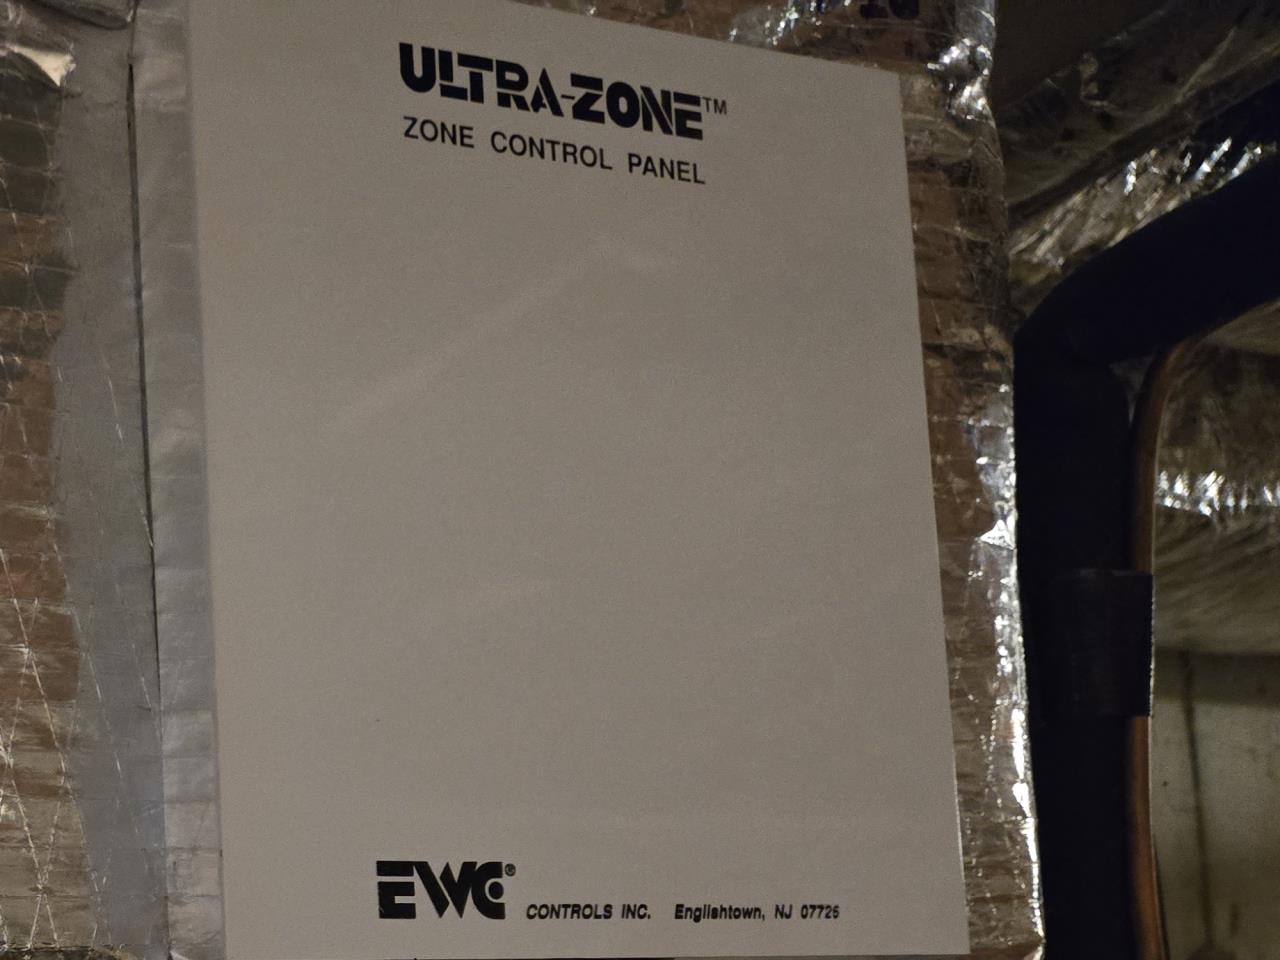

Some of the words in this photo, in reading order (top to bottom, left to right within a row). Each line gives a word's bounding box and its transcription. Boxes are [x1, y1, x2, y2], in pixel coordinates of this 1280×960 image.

[403, 115, 475, 149] ZONE
[490, 130, 613, 171] CONTROL
[627, 152, 706, 185] PANEL
[525, 903, 613, 920] CONTROLS
[621, 903, 651, 920] INC.
[674, 903, 766, 923] Englishtown,
[774, 903, 793, 919] NJ
